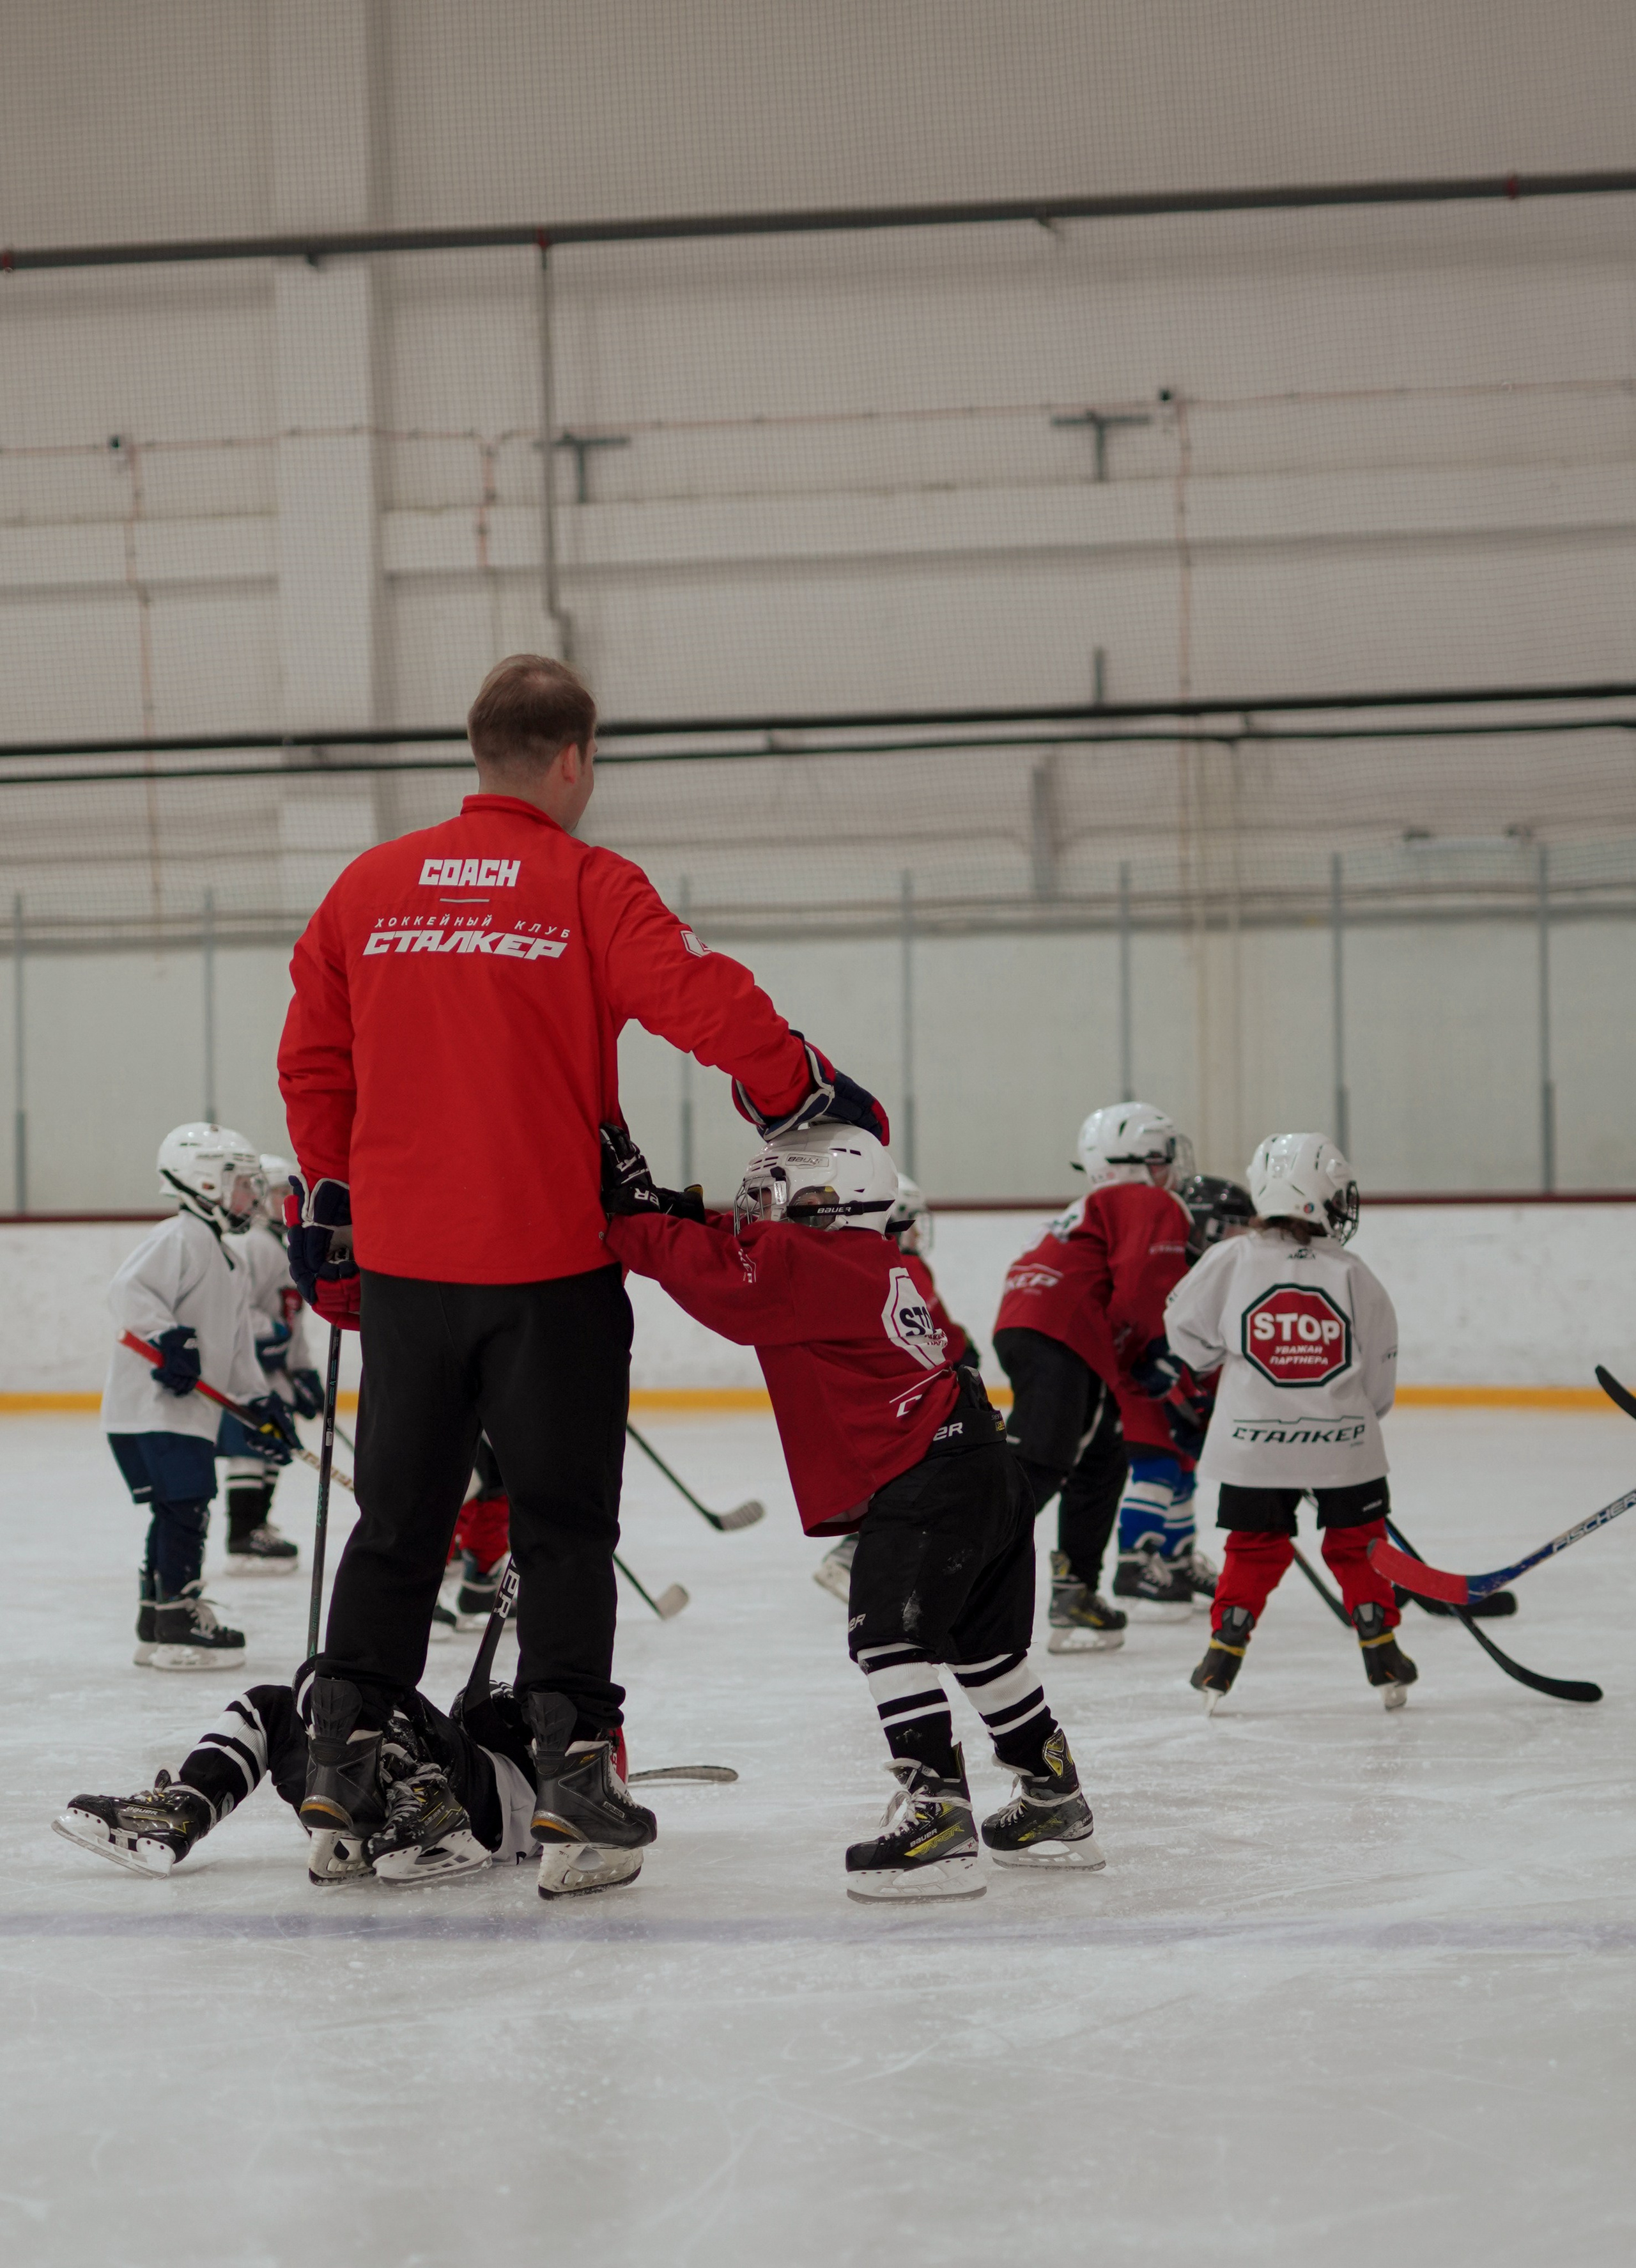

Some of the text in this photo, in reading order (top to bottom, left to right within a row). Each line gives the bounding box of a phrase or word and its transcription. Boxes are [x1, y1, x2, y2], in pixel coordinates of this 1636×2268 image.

[418, 858, 521, 887] COACH
[374, 913, 571, 938] ХОККЕЙНЫЙ КЛУБ
[362, 930, 568, 960] СТАЛКЕР
[1253, 1312, 1341, 1346] STOP
[1269, 1355, 1329, 1365] ПАРТНЕРА
[1232, 1424, 1365, 1443] СТАЛКЕР
[910, 1828, 938, 1848] BAUER
